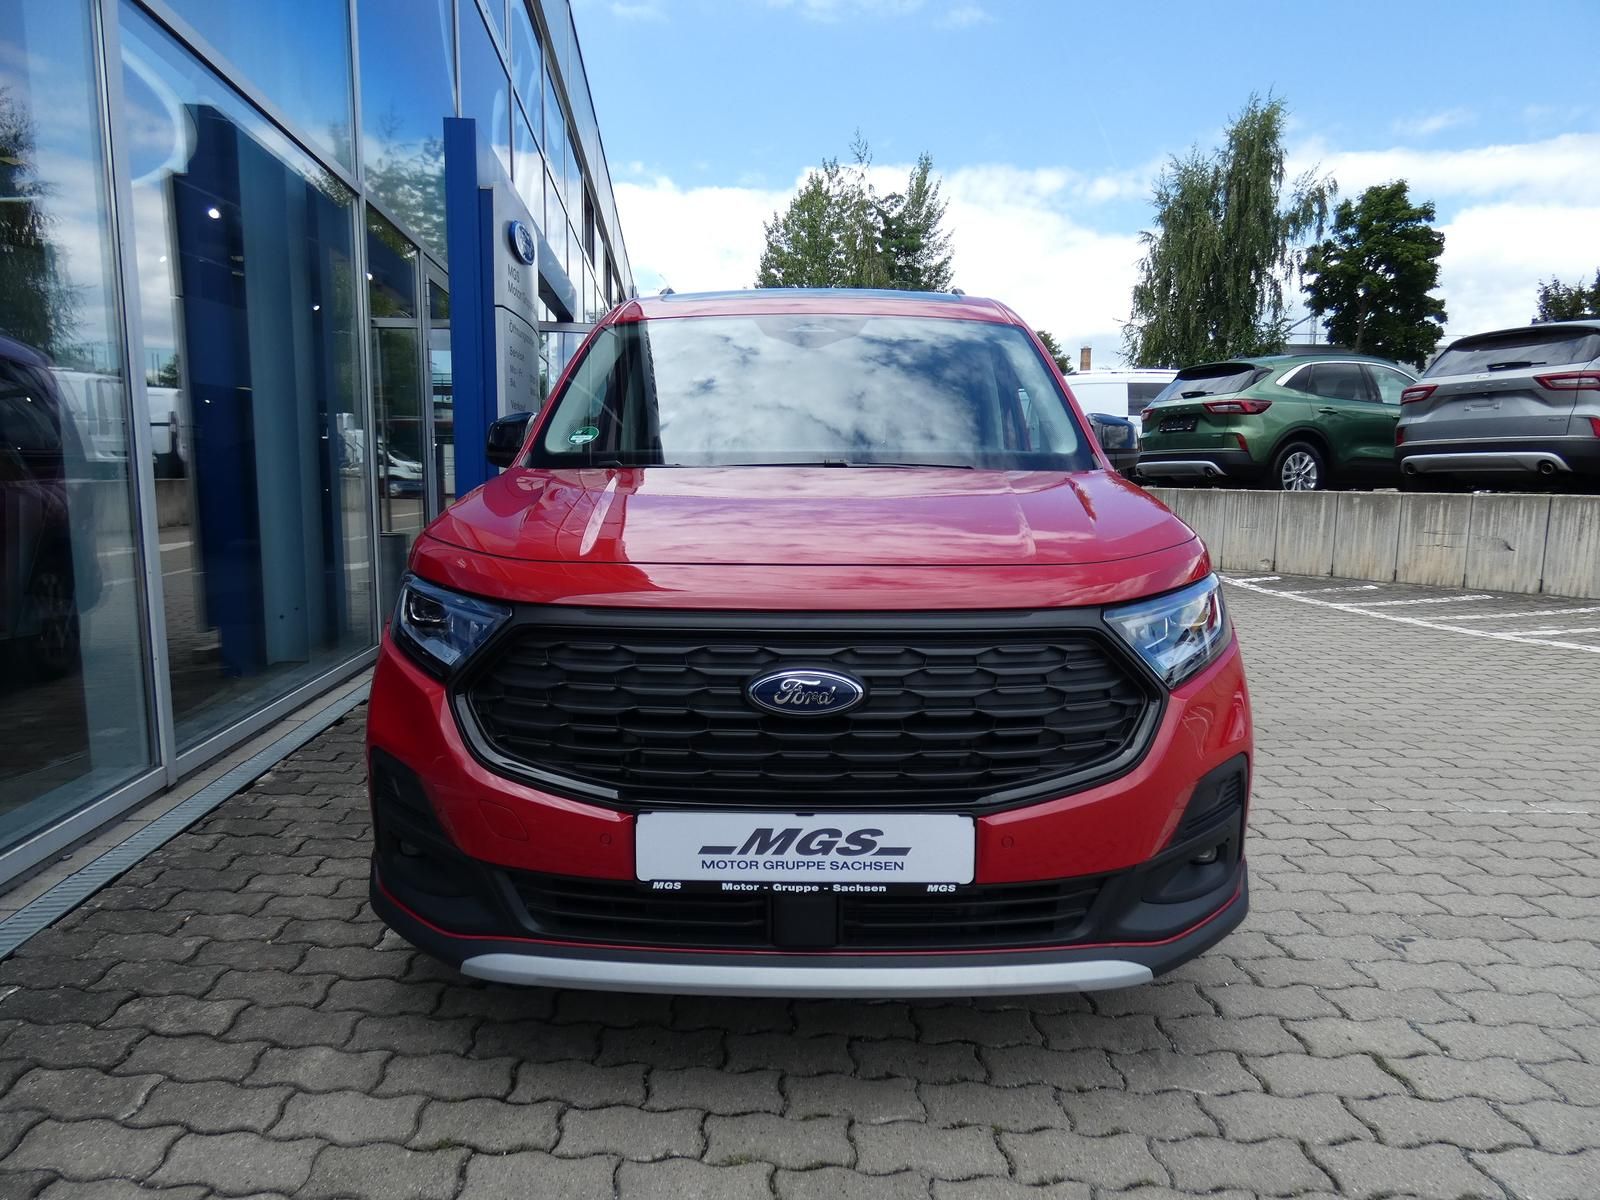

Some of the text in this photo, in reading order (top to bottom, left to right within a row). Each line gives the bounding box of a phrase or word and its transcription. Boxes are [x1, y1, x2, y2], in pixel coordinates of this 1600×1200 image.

[507, 263, 520, 284] MGS
[773, 678, 837, 705] Ford
[737, 827, 884, 856] MGS
[701, 859, 904, 871] MOTOR GRUPPE SACHSEN
[652, 881, 682, 890] MGS
[721, 883, 760, 892] Motor
[772, 883, 820, 893] Gruppe
[833, 883, 887, 893] Sachsen
[926, 884, 956, 893] MGS
